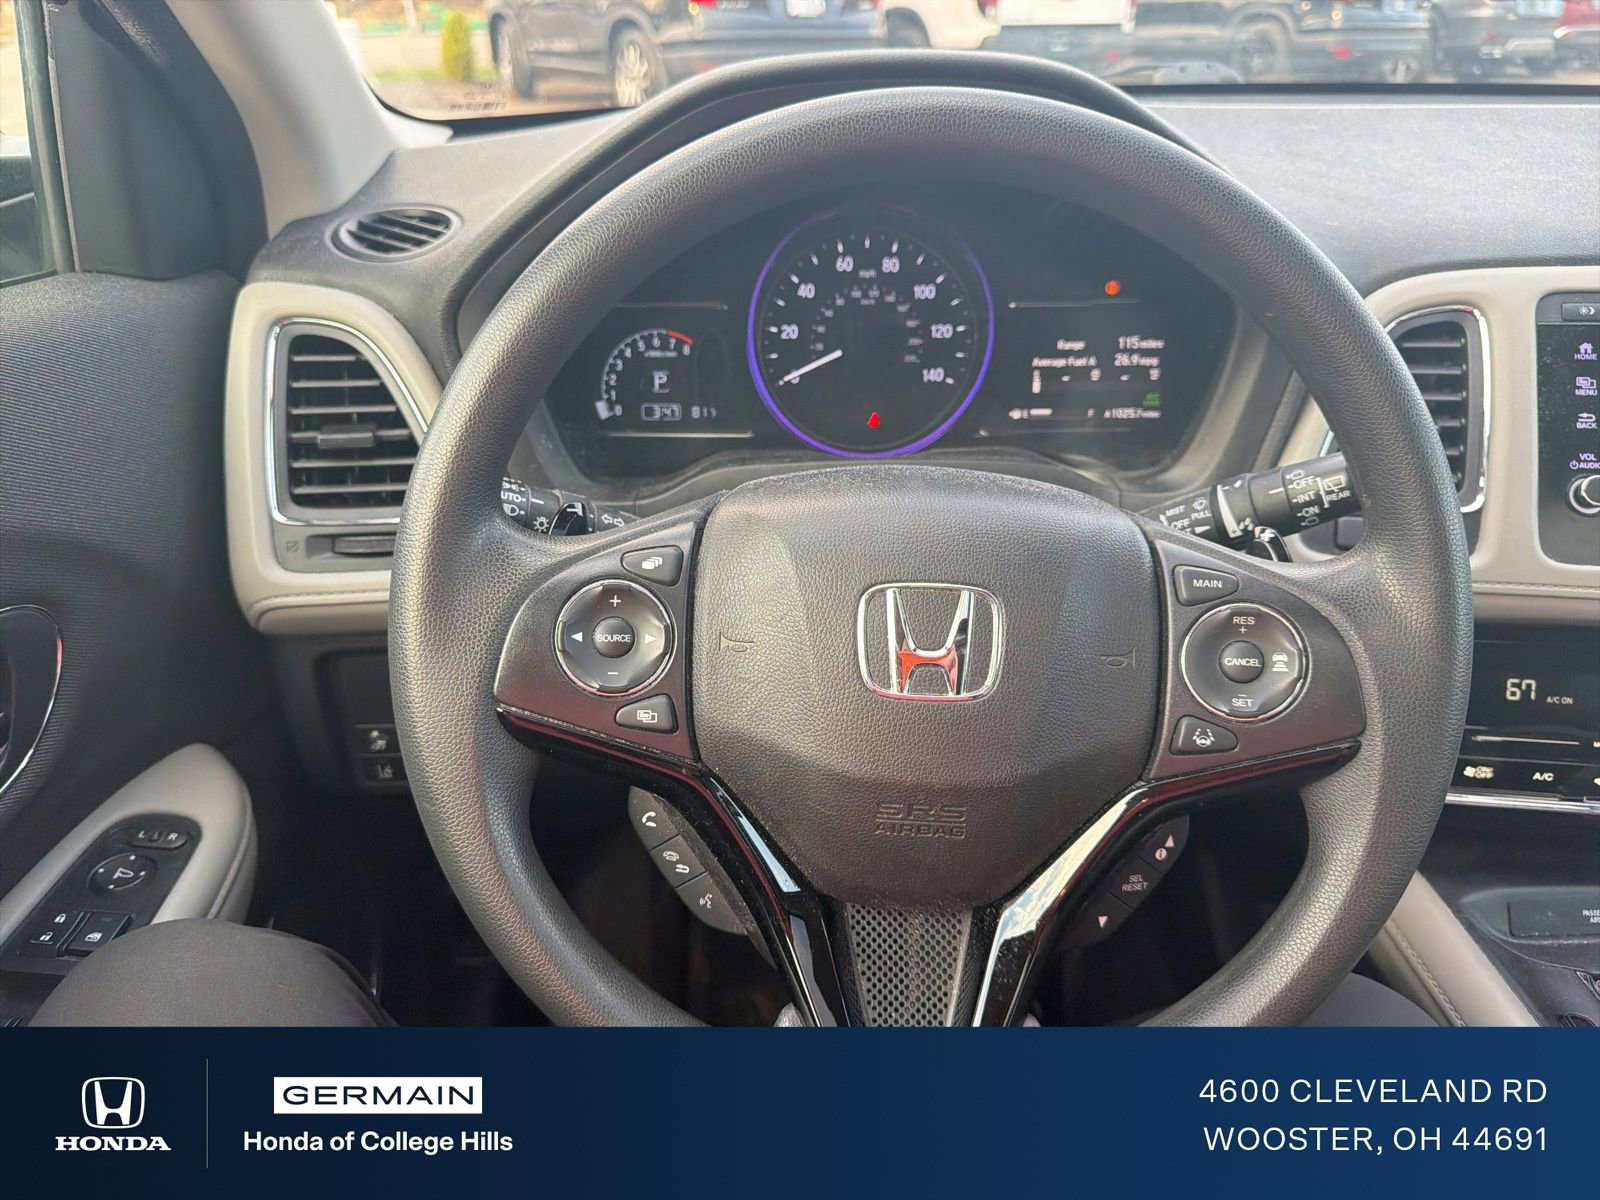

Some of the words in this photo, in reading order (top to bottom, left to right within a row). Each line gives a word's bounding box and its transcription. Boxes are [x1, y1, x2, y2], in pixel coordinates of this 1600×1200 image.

[836, 256, 853, 272] 60
[882, 256, 900, 272] 80
[798, 283, 815, 298] 40
[913, 284, 936, 299] 100
[781, 324, 799, 339] 20
[931, 324, 953, 339] 120
[923, 368, 944, 382] 140
[653, 374, 667, 390] P
[1575, 388, 1597, 396] MENU
[1579, 453, 1596, 461] VOL
[1293, 476, 1316, 489] OFF
[501, 490, 521, 502] UTO
[1297, 491, 1315, 503] INT
[1326, 489, 1351, 502] REAR
[1191, 510, 1212, 520] PULL
[1302, 505, 1319, 517] ON
[1171, 518, 1191, 530] OFF
[1193, 579, 1223, 588] MAIN
[1232, 616, 1255, 625] RES
[597, 634, 631, 643] SOURCE
[1225, 657, 1261, 667] CANCEL
[1506, 678, 1536, 701] 67
[1232, 698, 1253, 707] SET
[1532, 772, 1554, 781] A/C
[877, 804, 967, 820] SRS
[168, 832, 178, 840] R
[874, 821, 967, 839] AIRBAG
[1129, 873, 1143, 883] SEL
[1122, 882, 1149, 893] RESET
